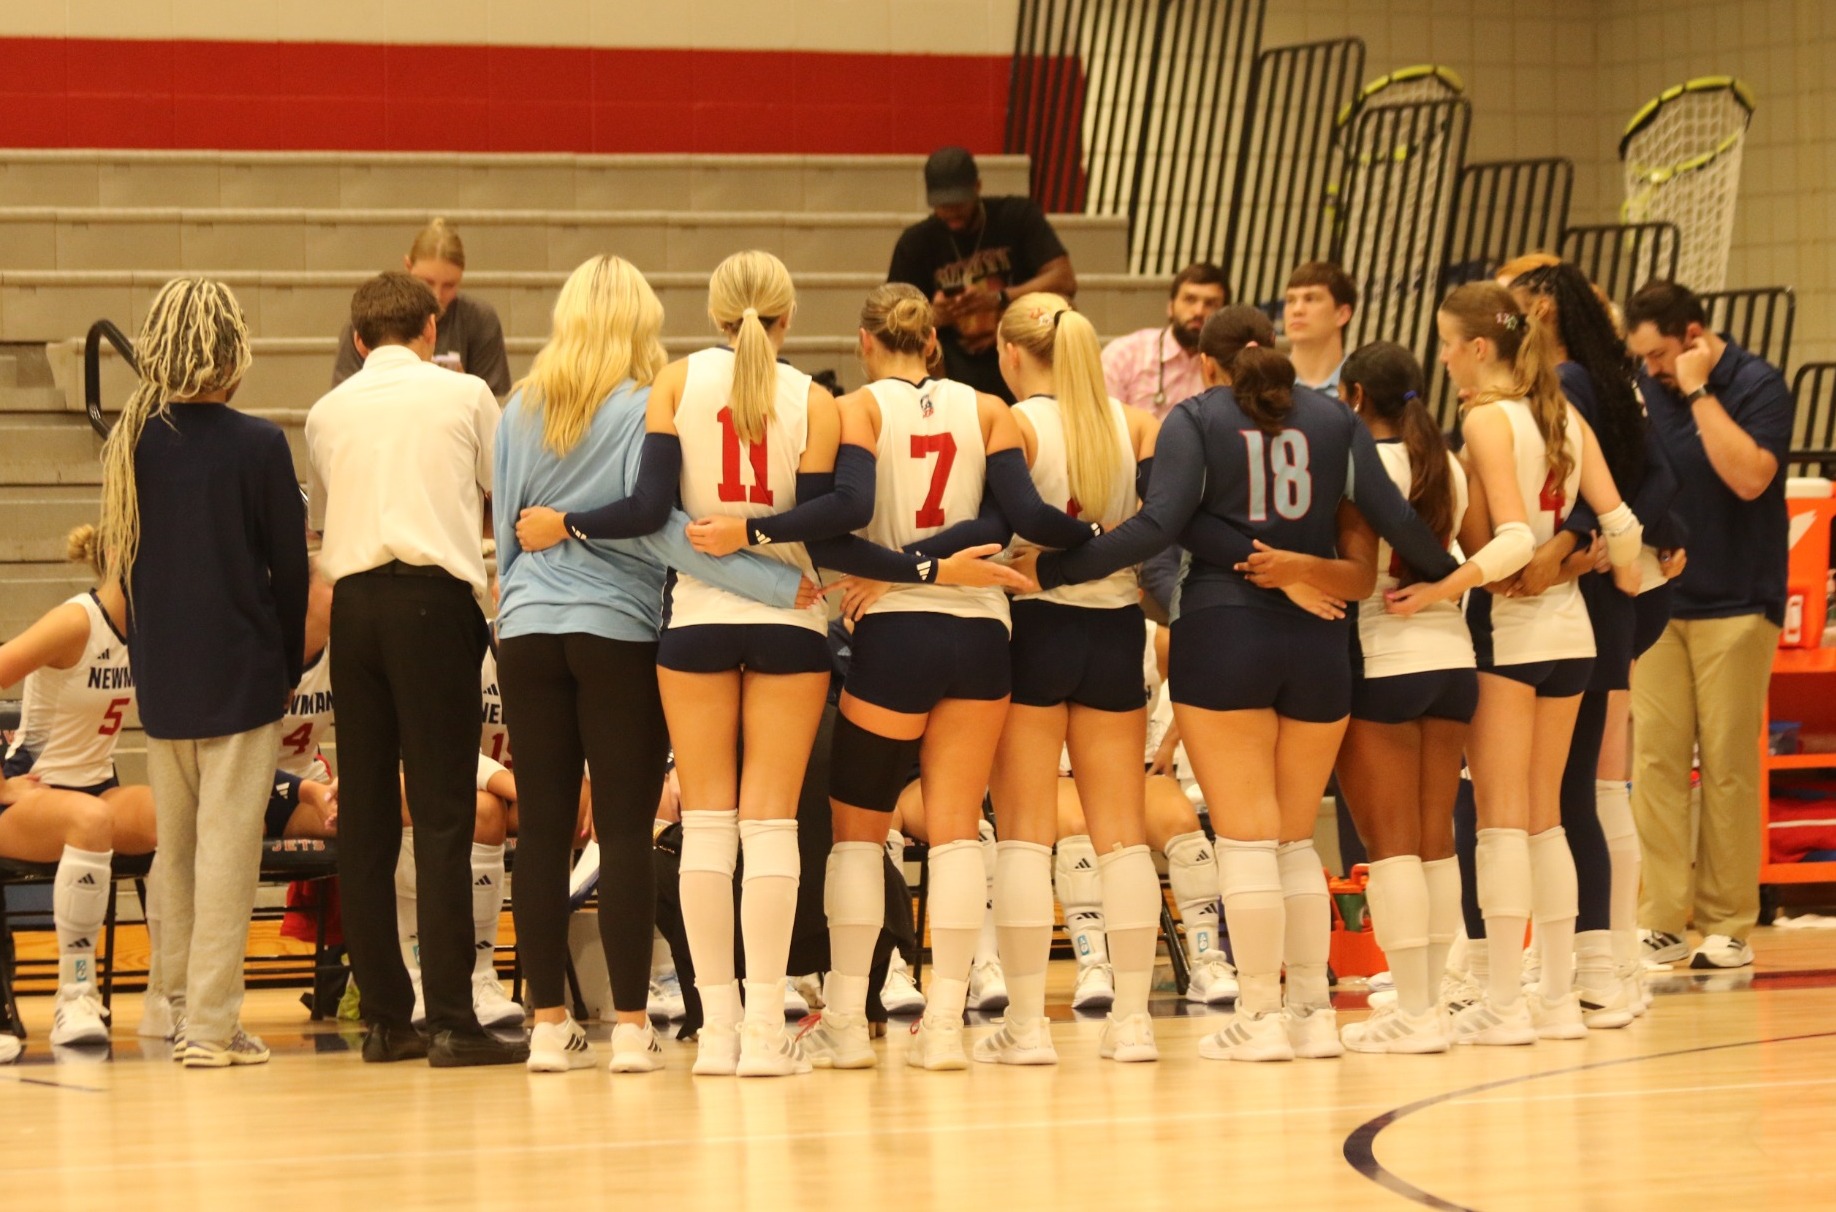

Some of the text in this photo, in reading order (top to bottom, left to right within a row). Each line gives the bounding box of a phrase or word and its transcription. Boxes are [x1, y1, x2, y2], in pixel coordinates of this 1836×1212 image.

[717, 405, 774, 507] 11
[910, 432, 957, 529] 7
[1239, 428, 1312, 521] 18
[98, 698, 131, 735] 5
[283, 722, 314, 755] 4
[272, 839, 326, 852] JETS
